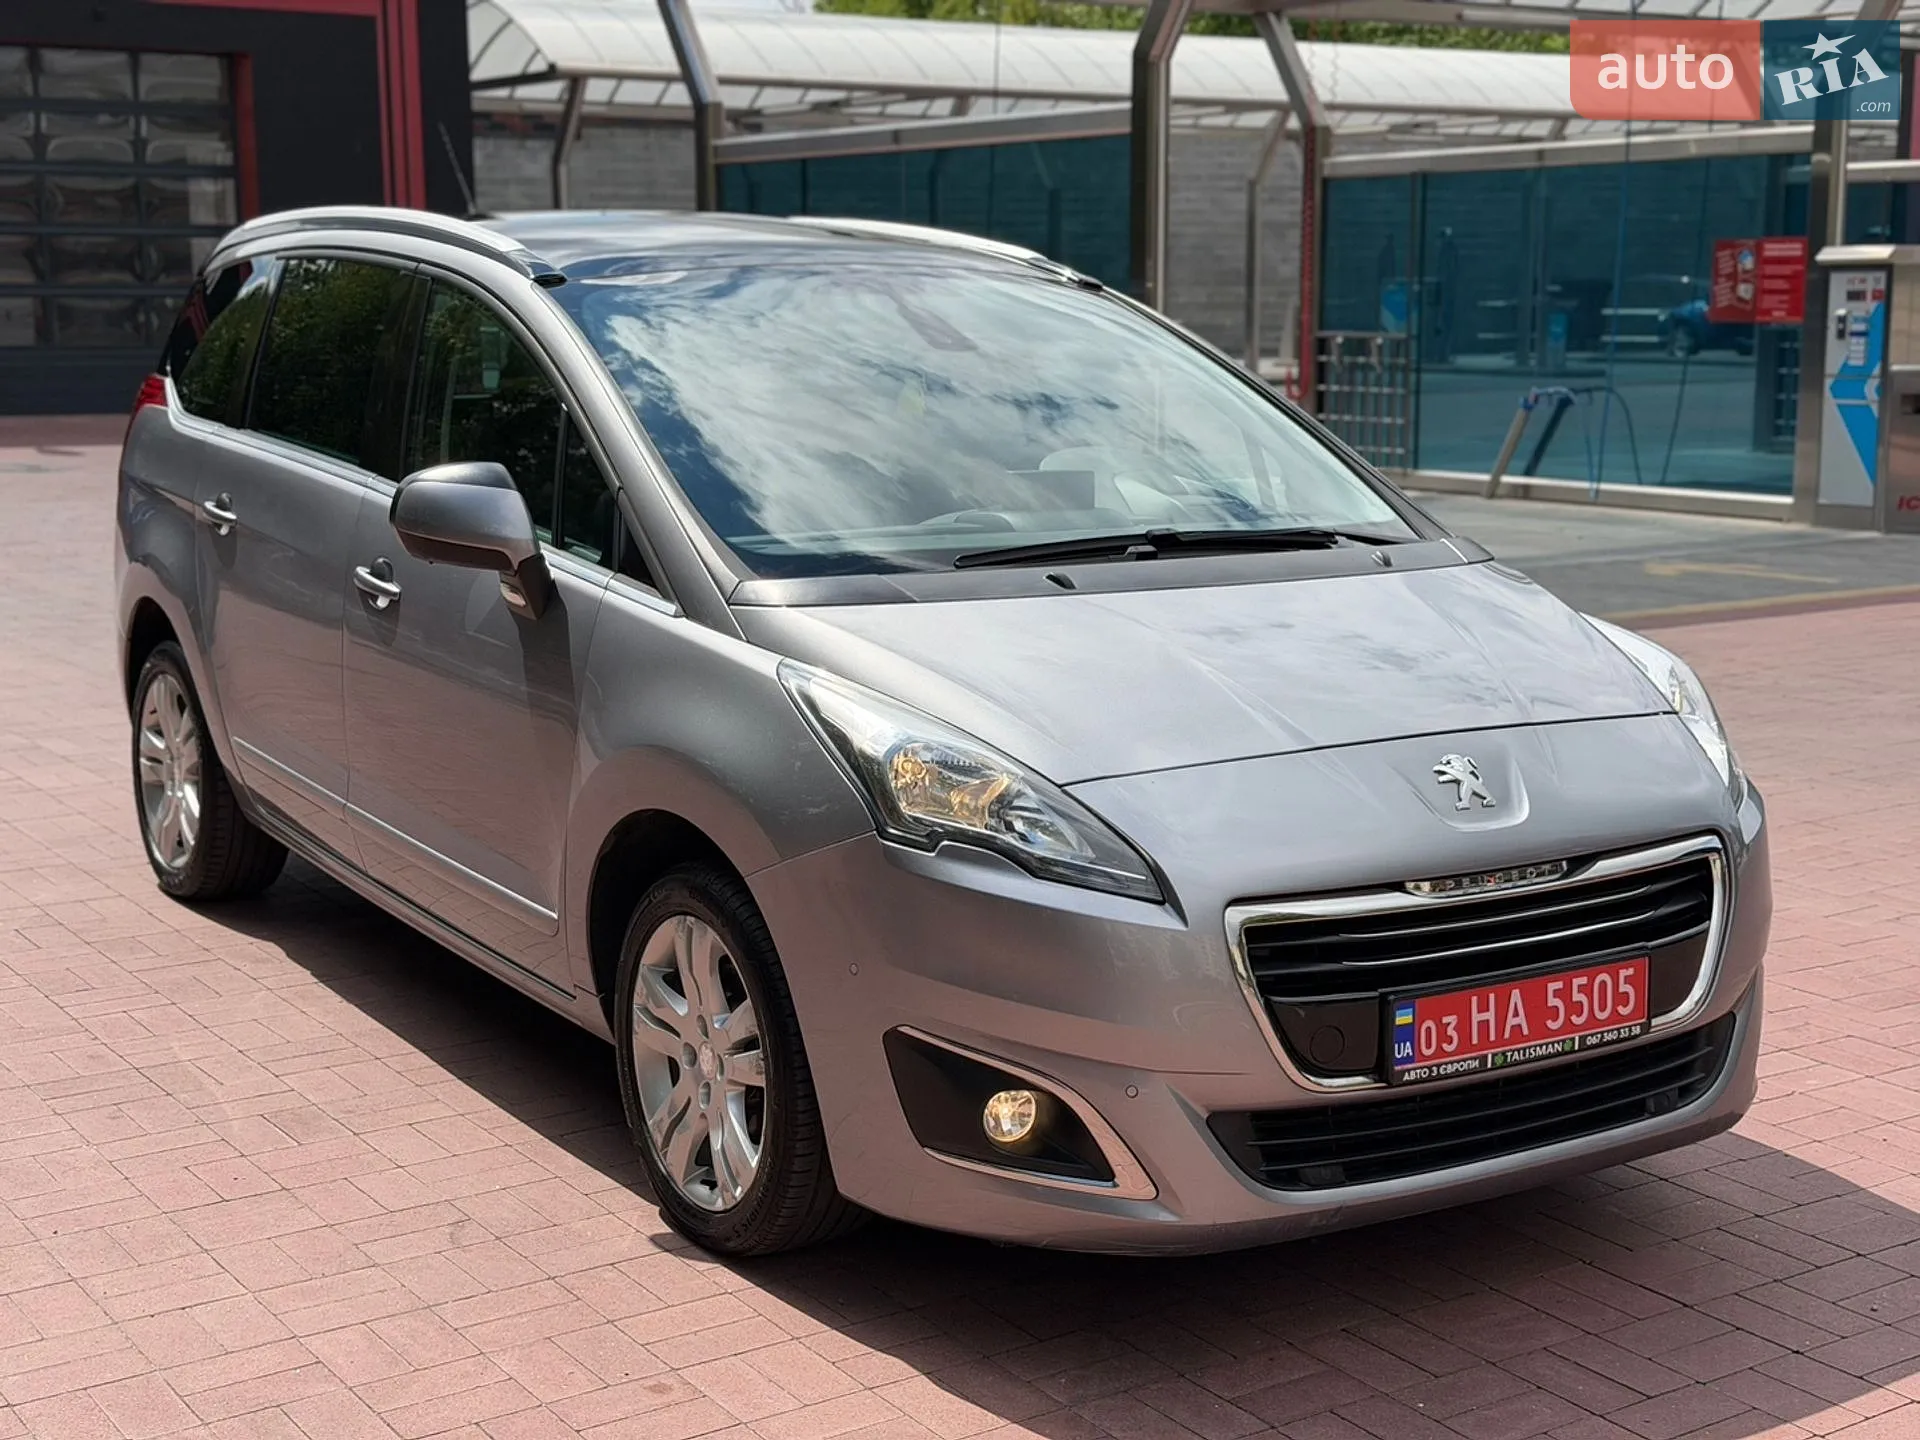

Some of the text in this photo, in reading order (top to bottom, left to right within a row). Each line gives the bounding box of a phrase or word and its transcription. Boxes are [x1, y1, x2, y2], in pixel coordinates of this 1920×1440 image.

[1420, 967, 1637, 1057] 03 HA 5505
[1394, 1041, 1413, 1059] UA
[1586, 1033, 1602, 1046] 067
[1505, 1041, 1563, 1063] TALISMAN
[1402, 1067, 1430, 1081] АВТО
[1439, 1058, 1480, 1075] ЄВРОПИ
